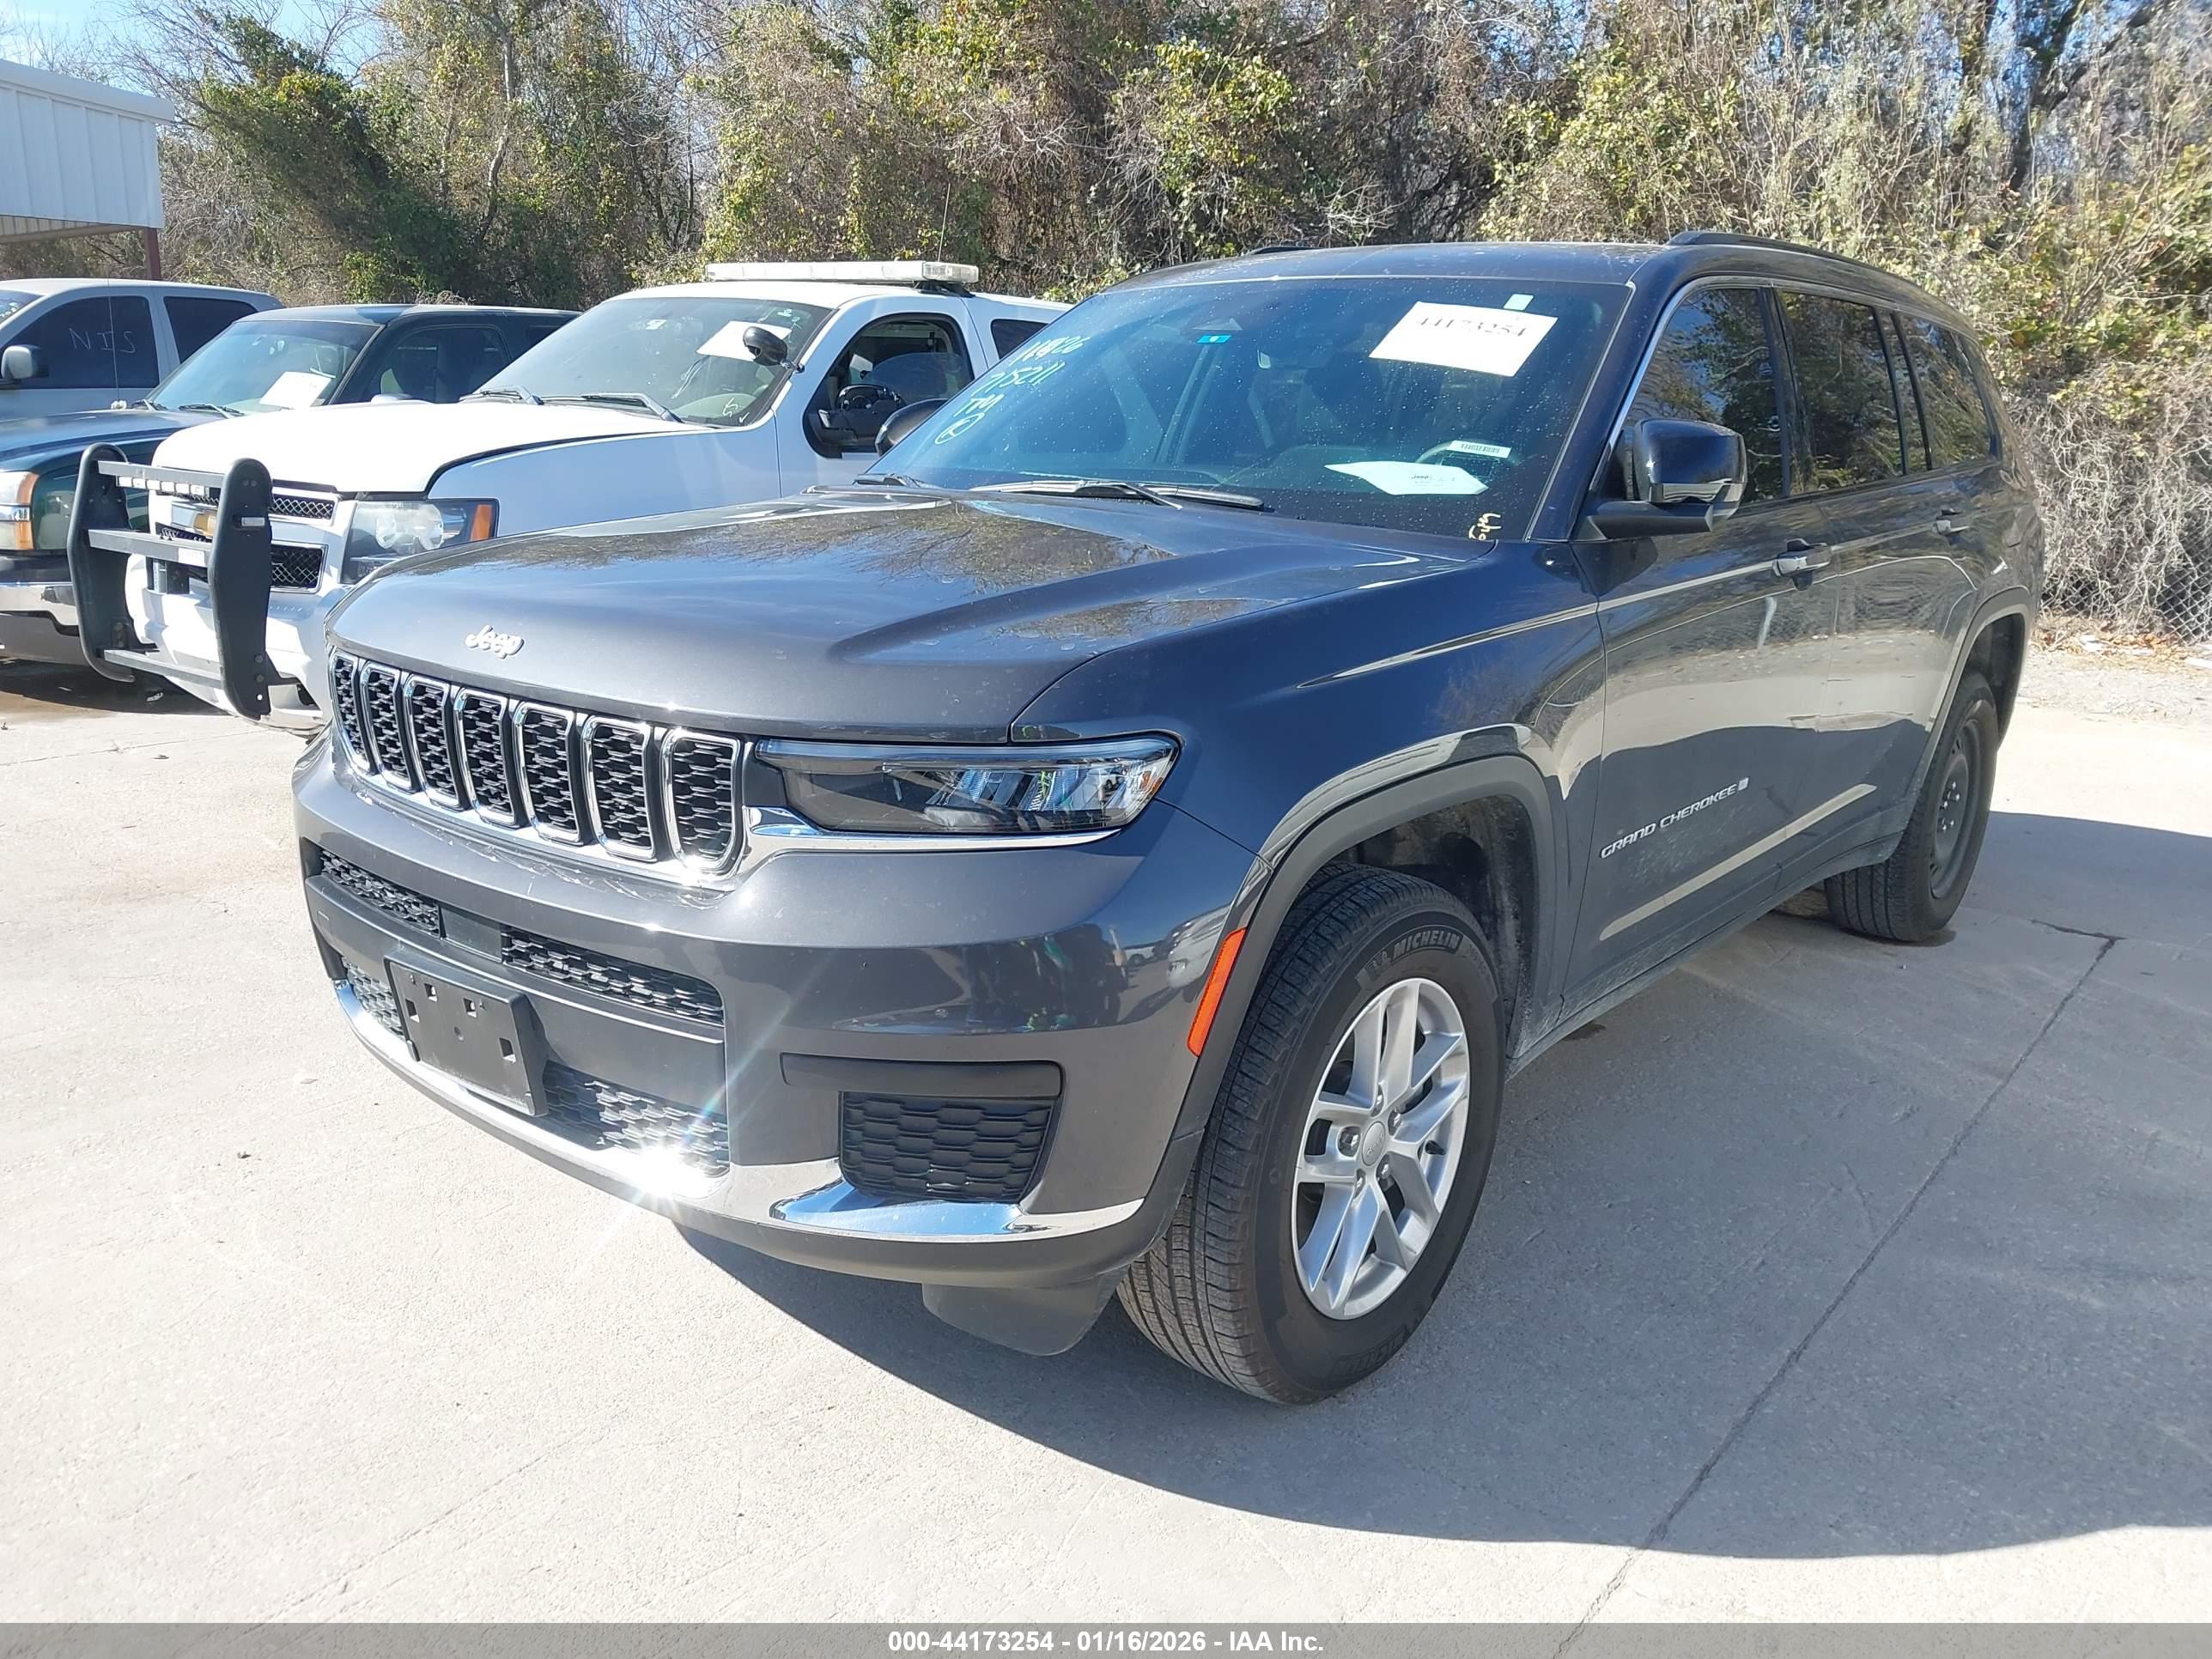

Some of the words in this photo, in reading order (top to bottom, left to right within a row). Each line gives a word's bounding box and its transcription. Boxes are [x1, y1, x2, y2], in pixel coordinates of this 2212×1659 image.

[69, 328, 136, 354] NIS
[465, 624, 525, 659] Jeep
[1601, 823, 1656, 859] GRAND
[1659, 783, 1737, 829] CHEROKEE
[1393, 929, 1460, 960] MICHELIN
